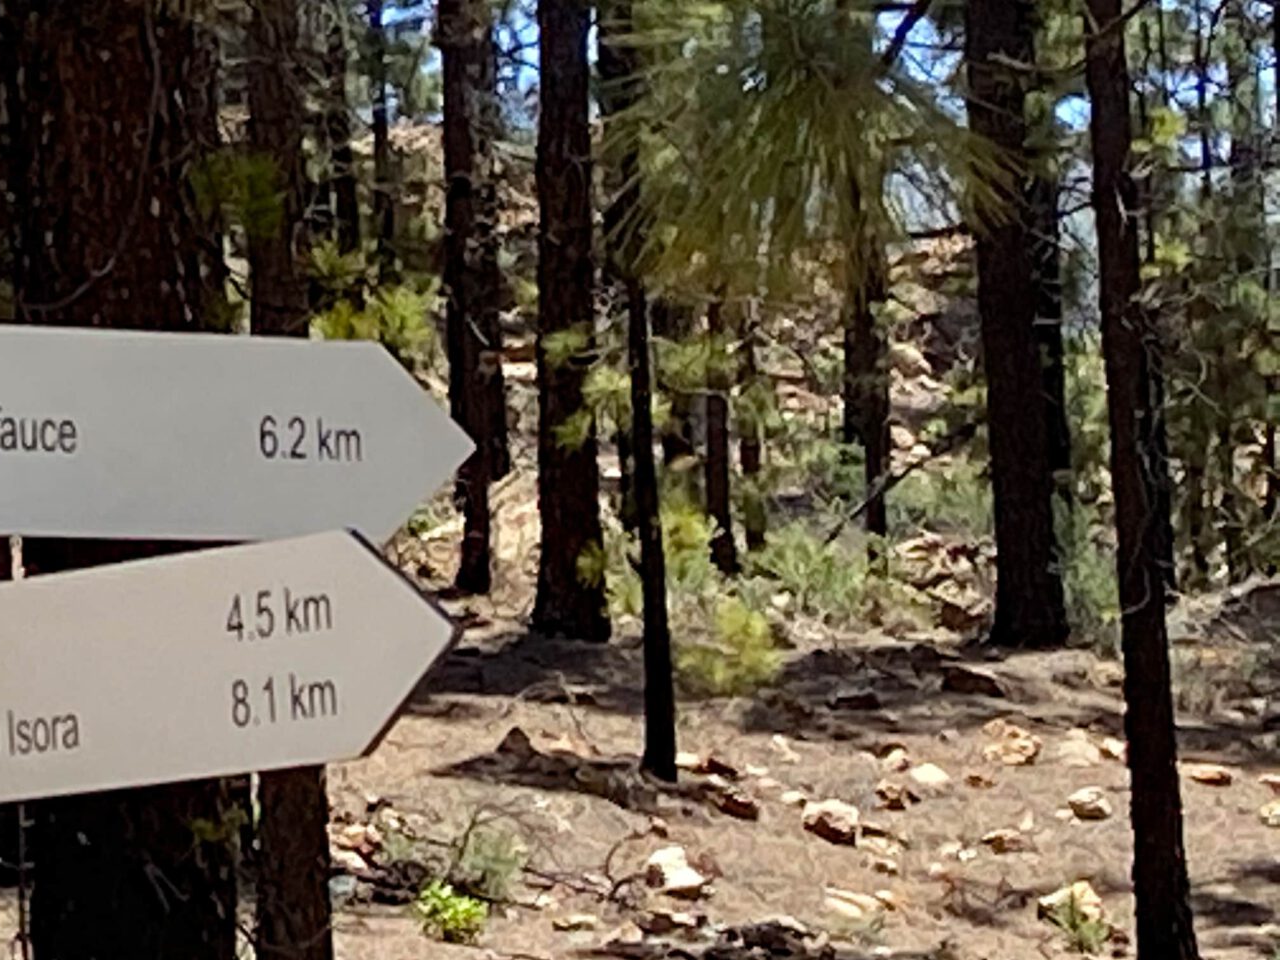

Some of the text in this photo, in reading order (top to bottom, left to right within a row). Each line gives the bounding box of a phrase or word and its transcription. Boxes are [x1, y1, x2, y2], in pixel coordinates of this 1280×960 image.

[260, 414, 363, 462] 6.2 km
[226, 586, 333, 642] 4.5 km
[232, 671, 338, 728] 8.1 km
[7, 709, 80, 756] Isora
